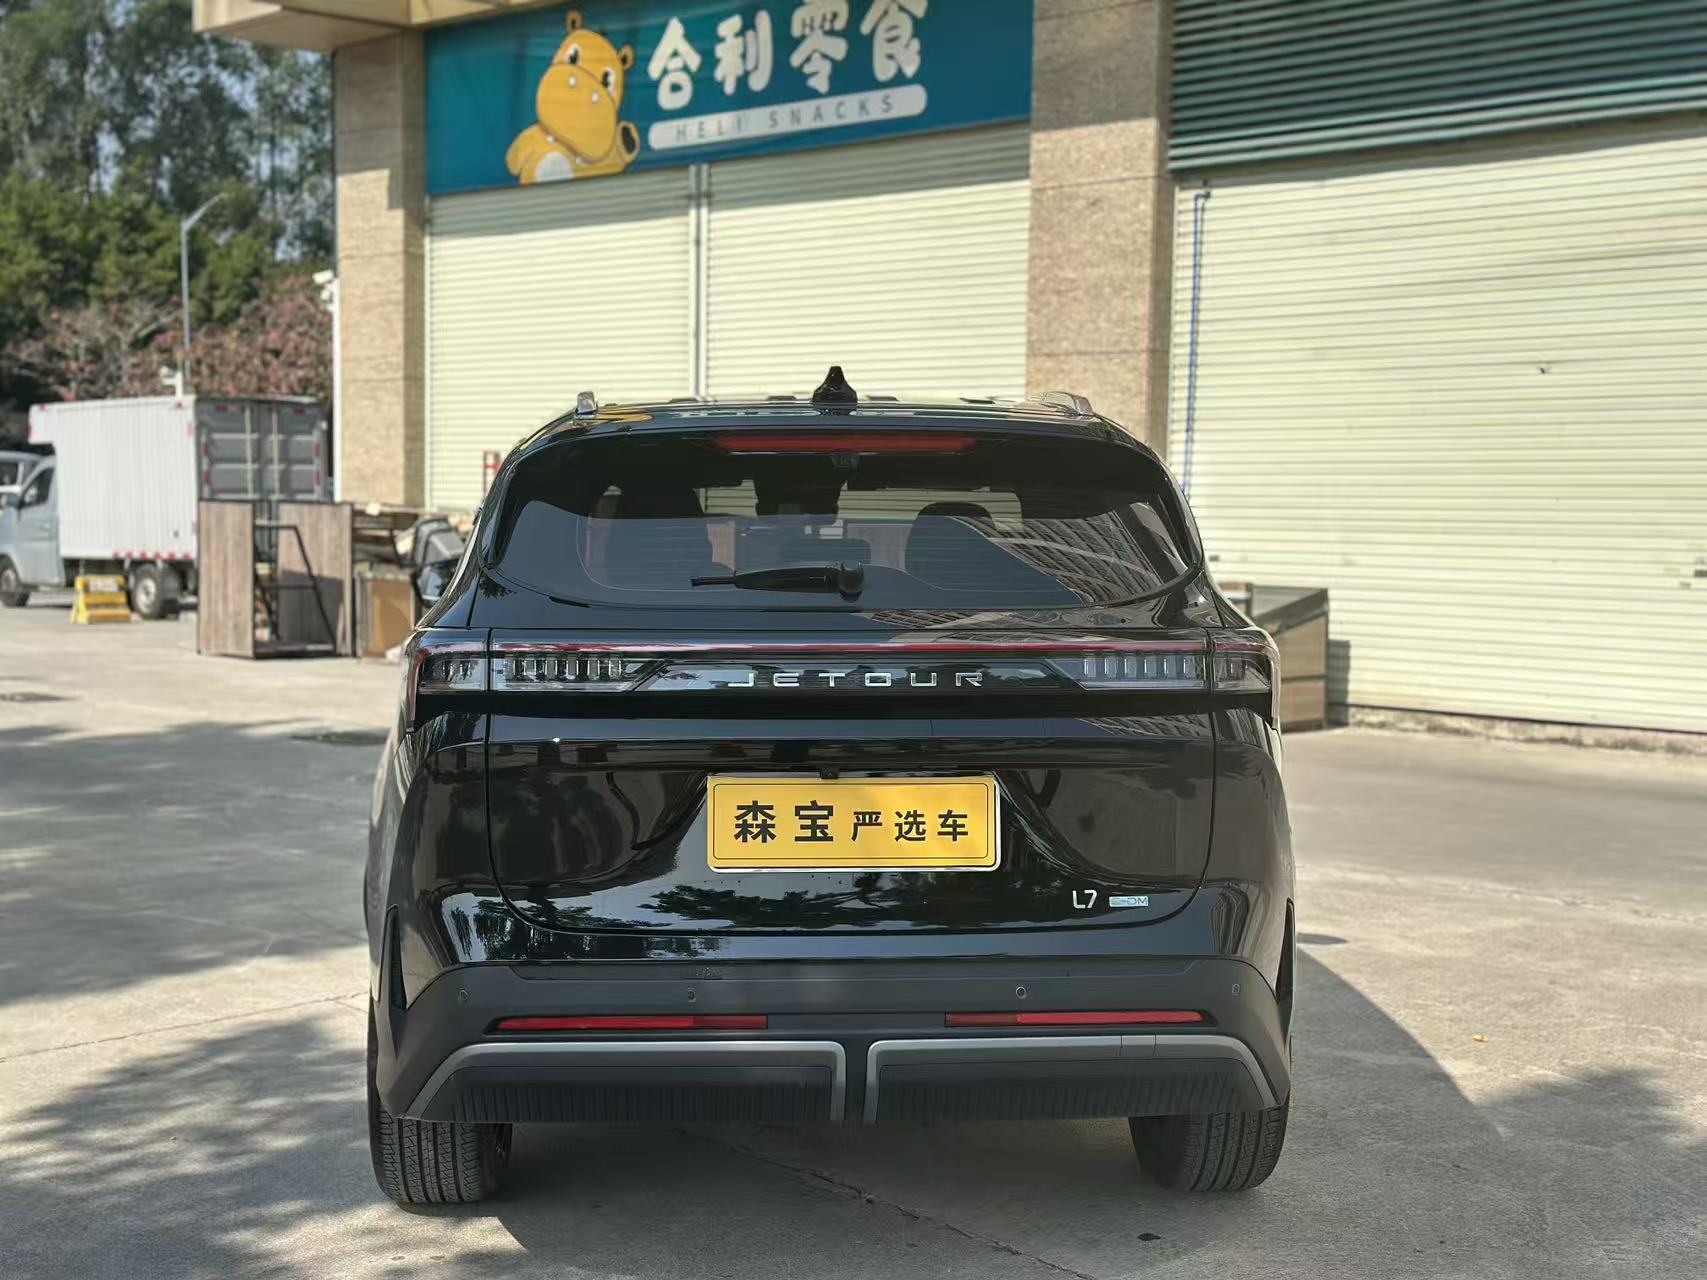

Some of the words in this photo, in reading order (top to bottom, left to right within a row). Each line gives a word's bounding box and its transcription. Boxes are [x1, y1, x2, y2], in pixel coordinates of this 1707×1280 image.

[648, 0, 928, 110] 合利零食
[676, 114, 743, 142] HELI
[768, 95, 894, 129] SNACKS
[727, 672, 983, 687] JETOUR
[734, 800, 969, 843] 森宝严选车
[1072, 889, 1098, 909] L7
